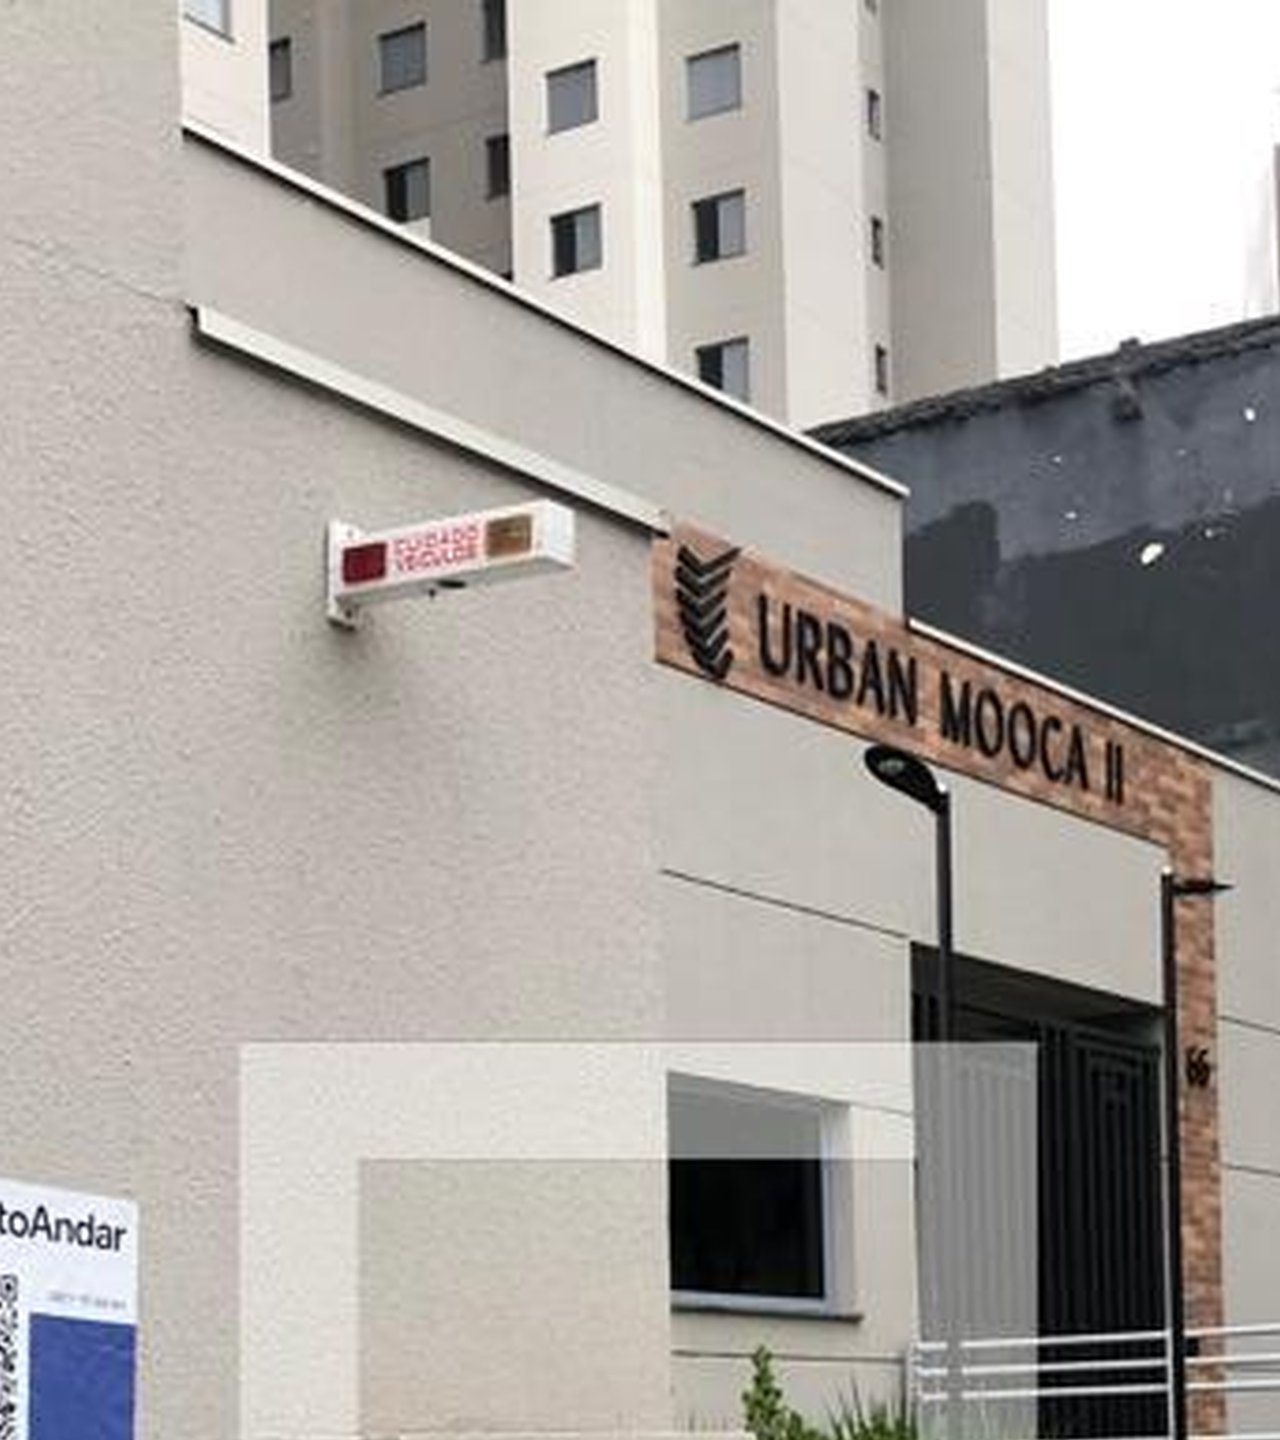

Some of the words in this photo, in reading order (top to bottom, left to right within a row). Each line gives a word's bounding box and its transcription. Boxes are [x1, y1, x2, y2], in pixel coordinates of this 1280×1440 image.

[757, 592, 918, 728] URBAN
[939, 670, 1089, 793] MOOCA
[1106, 739, 1125, 807] II
